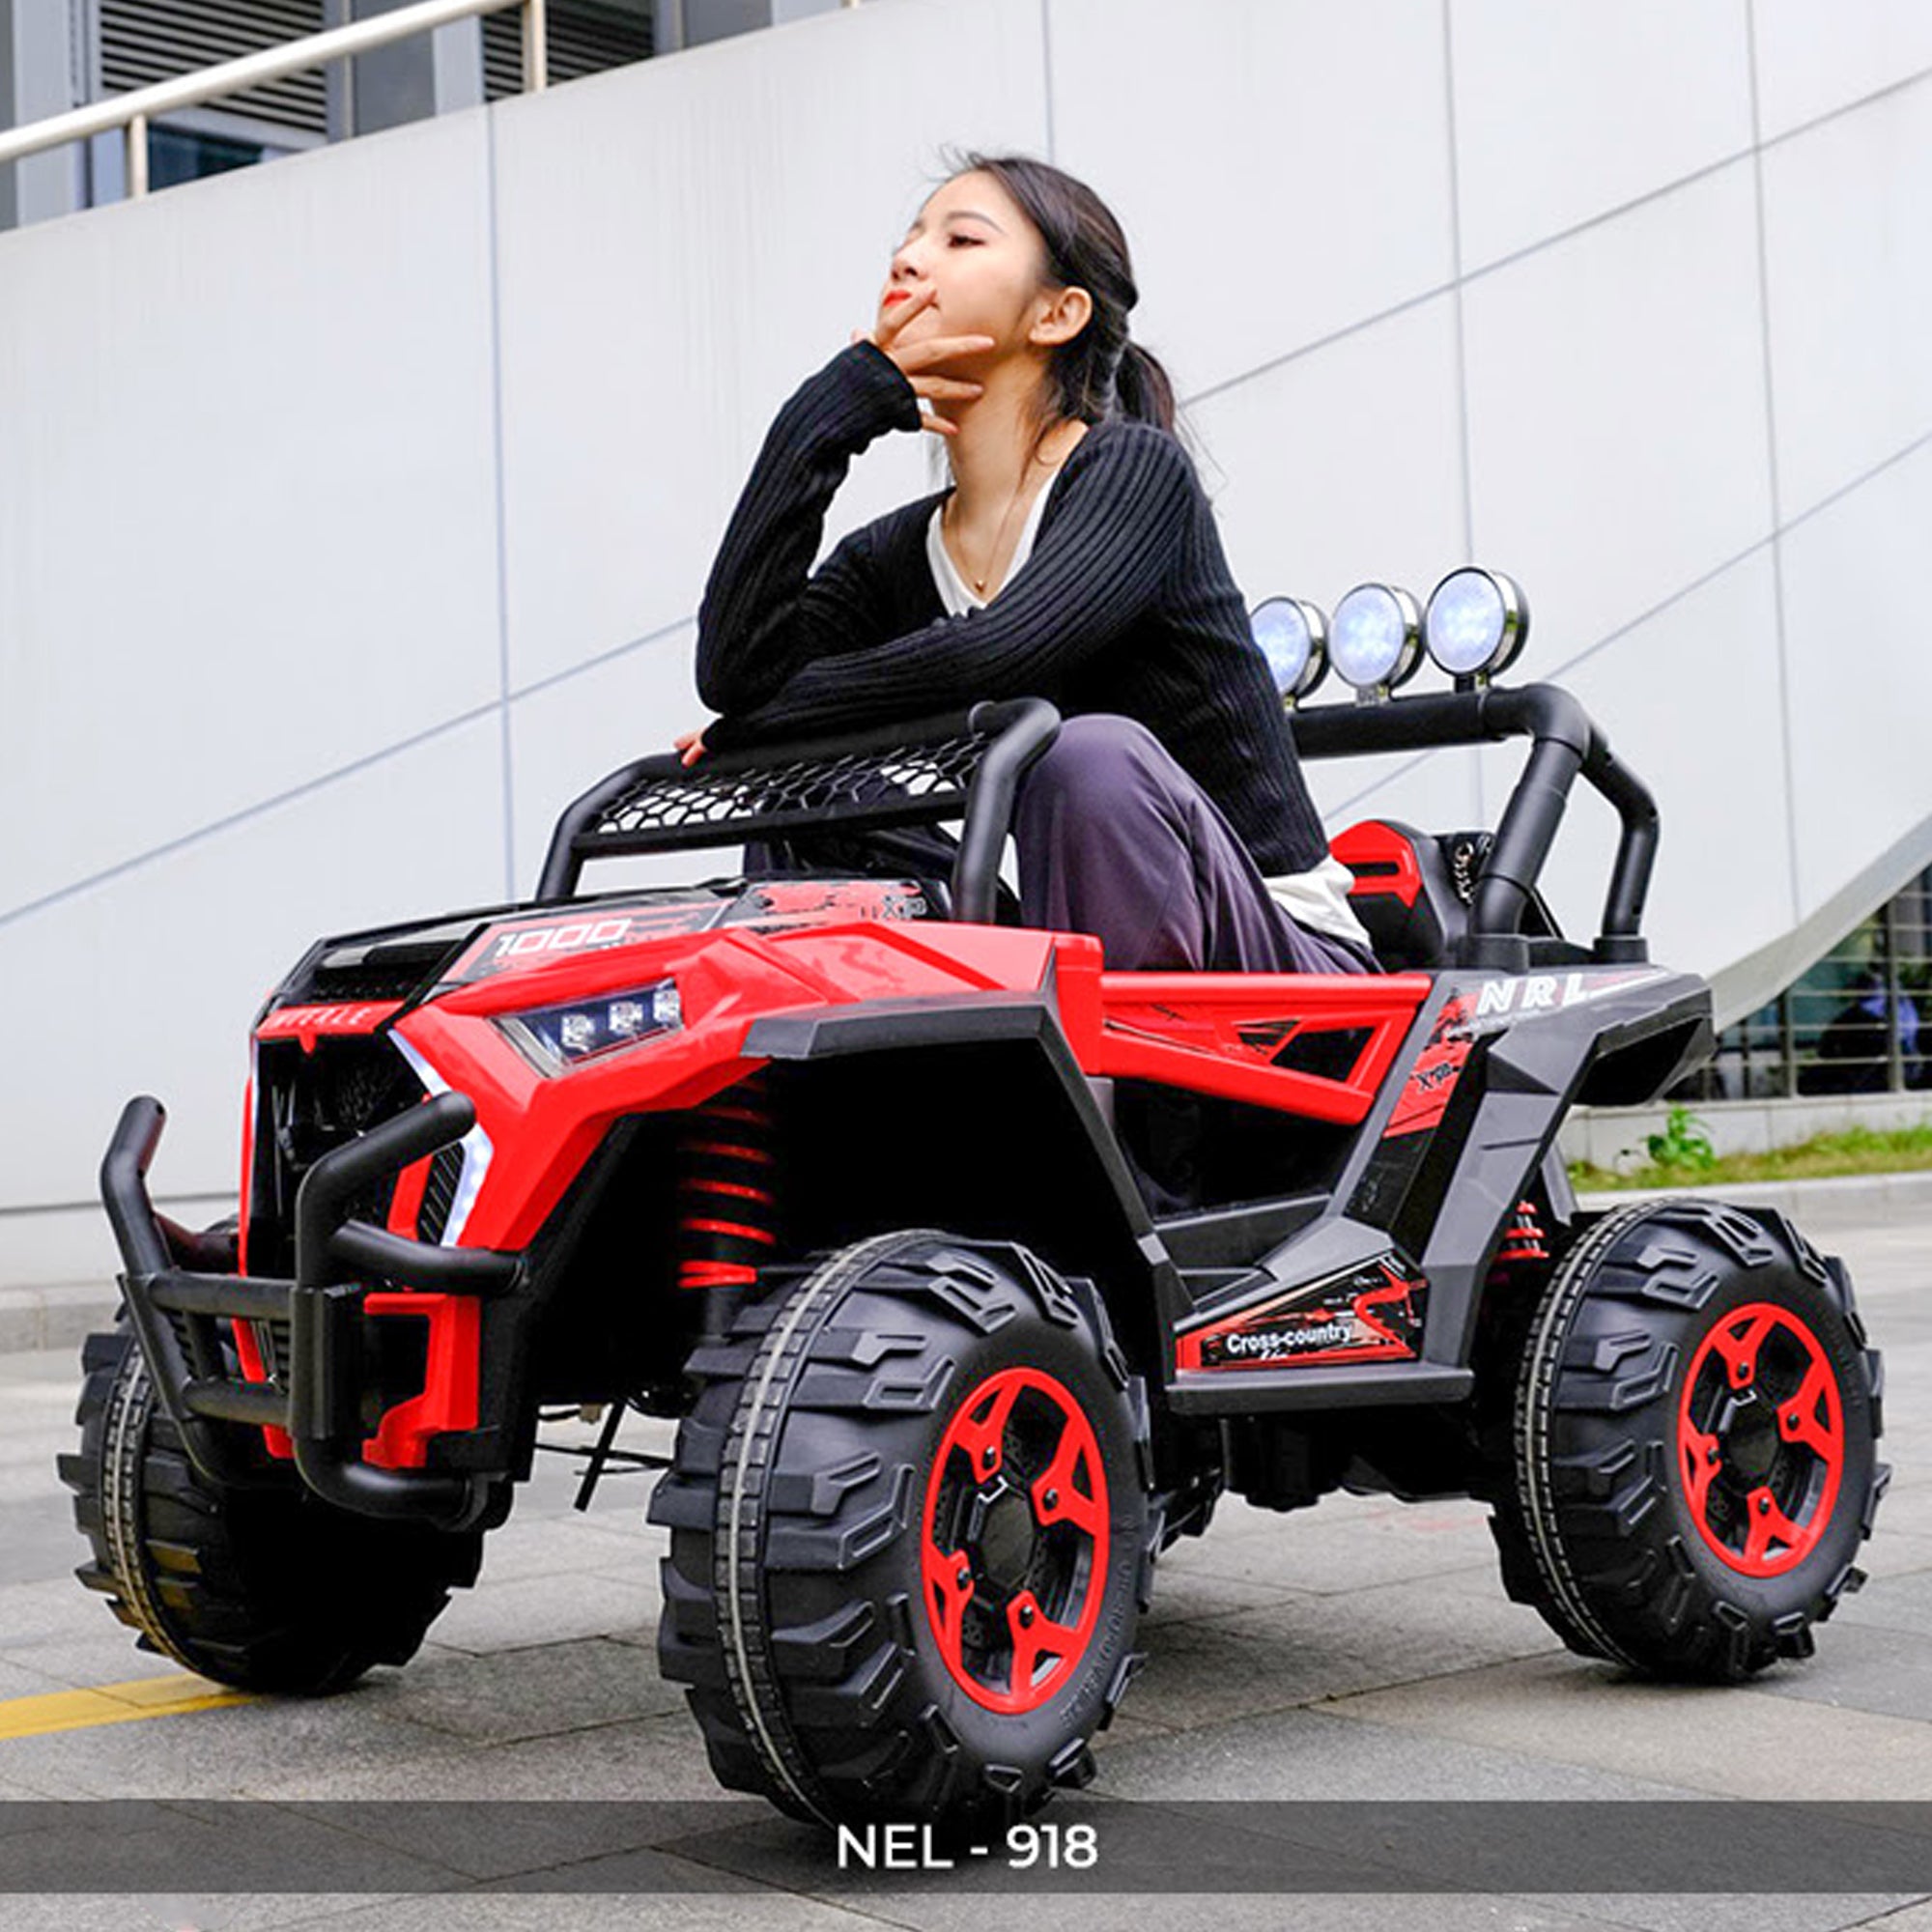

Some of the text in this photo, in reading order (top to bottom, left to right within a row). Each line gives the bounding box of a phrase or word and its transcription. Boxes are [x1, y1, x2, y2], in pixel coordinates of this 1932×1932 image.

[495, 918, 632, 957] 1000
[1475, 972, 1587, 1014] NRL
[1226, 1322, 1351, 1354] Cross-country
